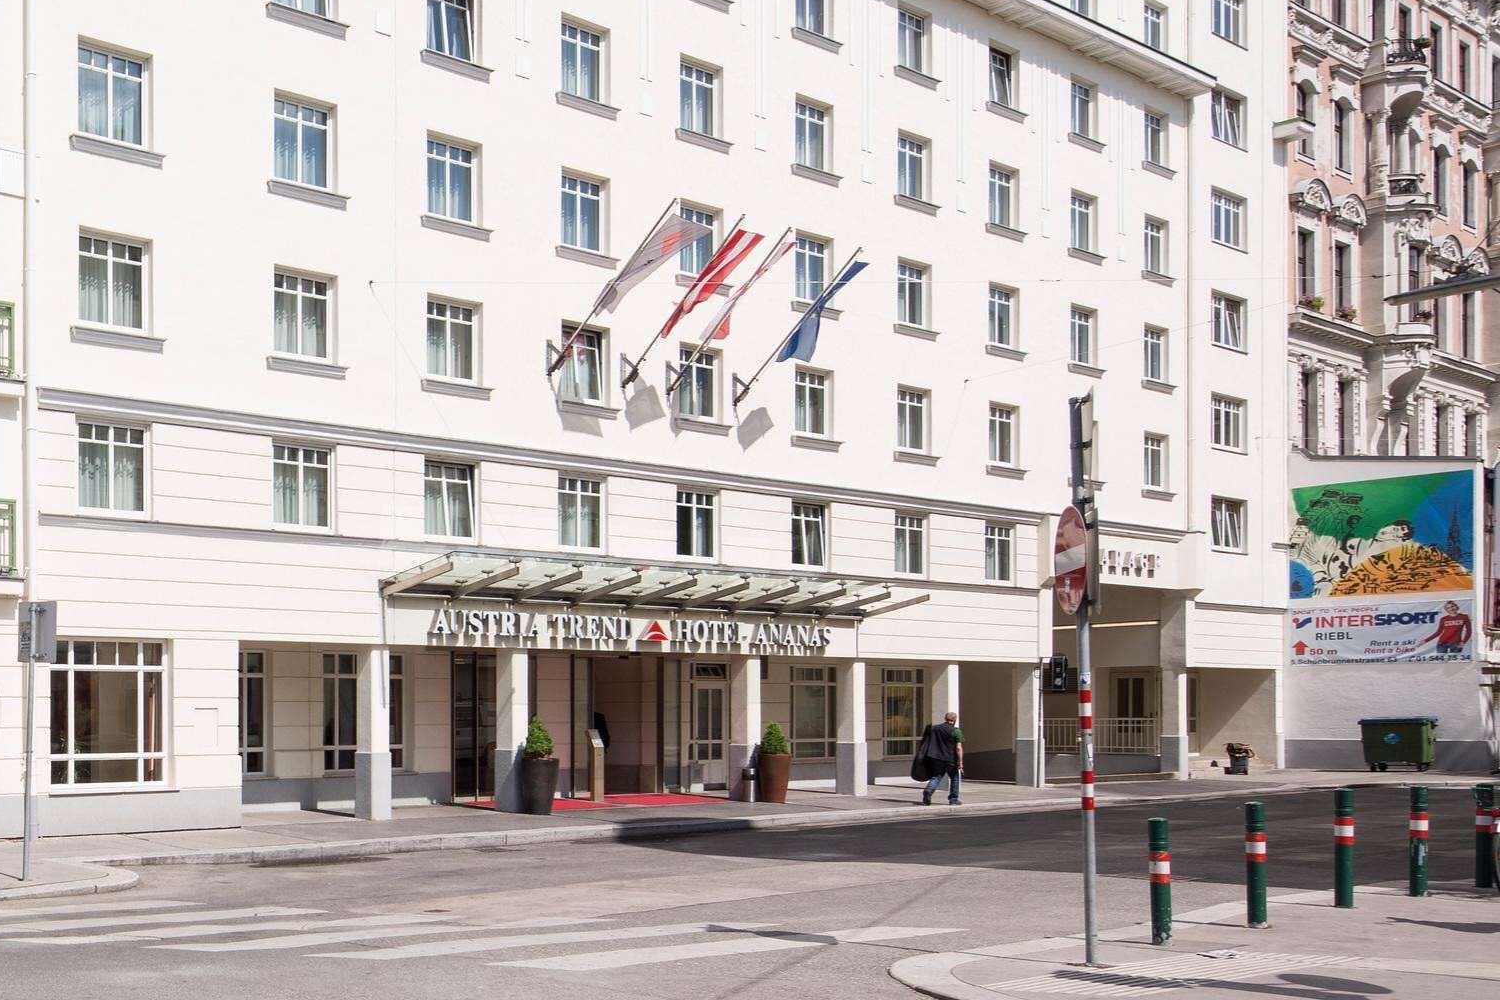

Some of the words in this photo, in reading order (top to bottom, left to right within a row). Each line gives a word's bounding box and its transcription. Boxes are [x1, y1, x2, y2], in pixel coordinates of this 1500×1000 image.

[433, 608, 549, 636] AUSTRIA
[675, 619, 749, 643] HOTEL
[755, 623, 834, 647] ANANAS
[1315, 611, 1439, 628] INTERSPORT
[1315, 632, 1353, 640] RIEBL
